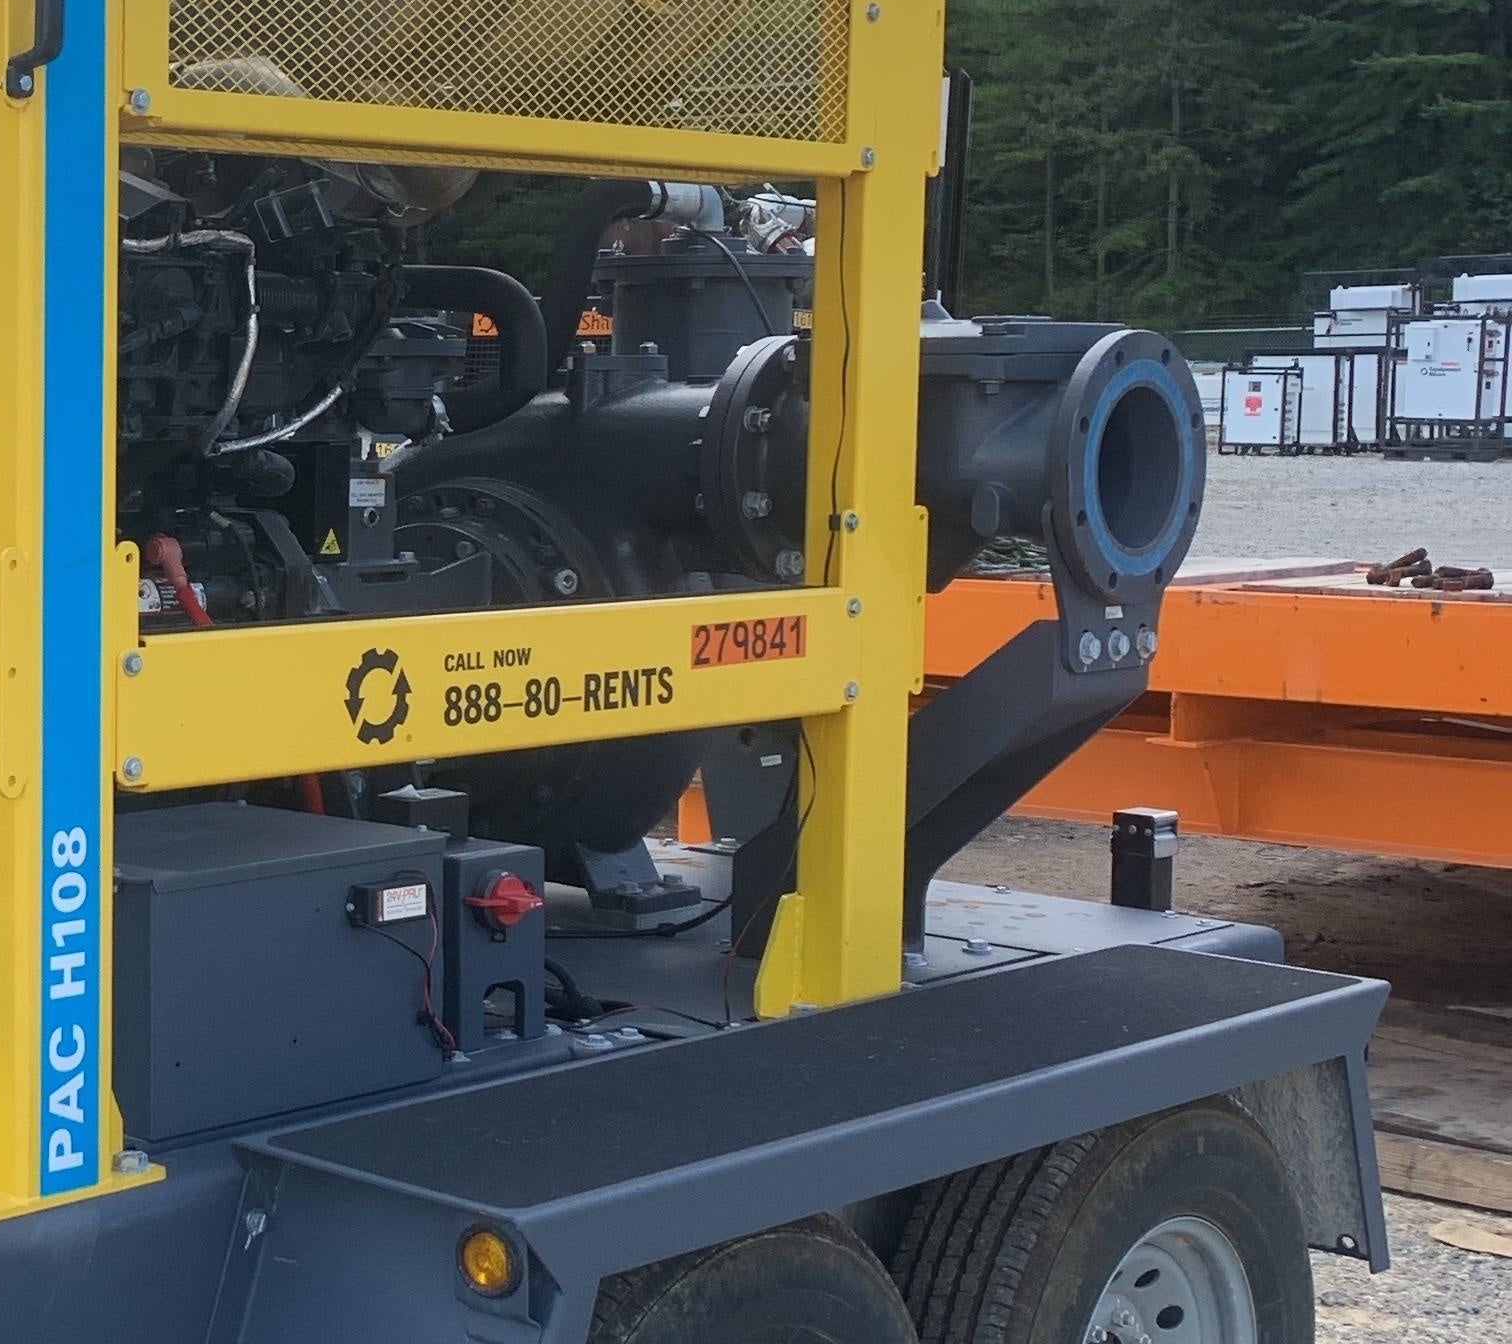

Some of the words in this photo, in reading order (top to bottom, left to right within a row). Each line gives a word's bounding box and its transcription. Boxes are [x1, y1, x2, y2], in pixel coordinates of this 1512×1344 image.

[443, 651, 486, 673] CALL
[492, 647, 532, 668] NOW
[693, 617, 804, 666] 279841
[443, 666, 674, 727] 888-80-RENTS
[49, 825, 88, 1002] H108
[48, 1022, 86, 1174] PAC
